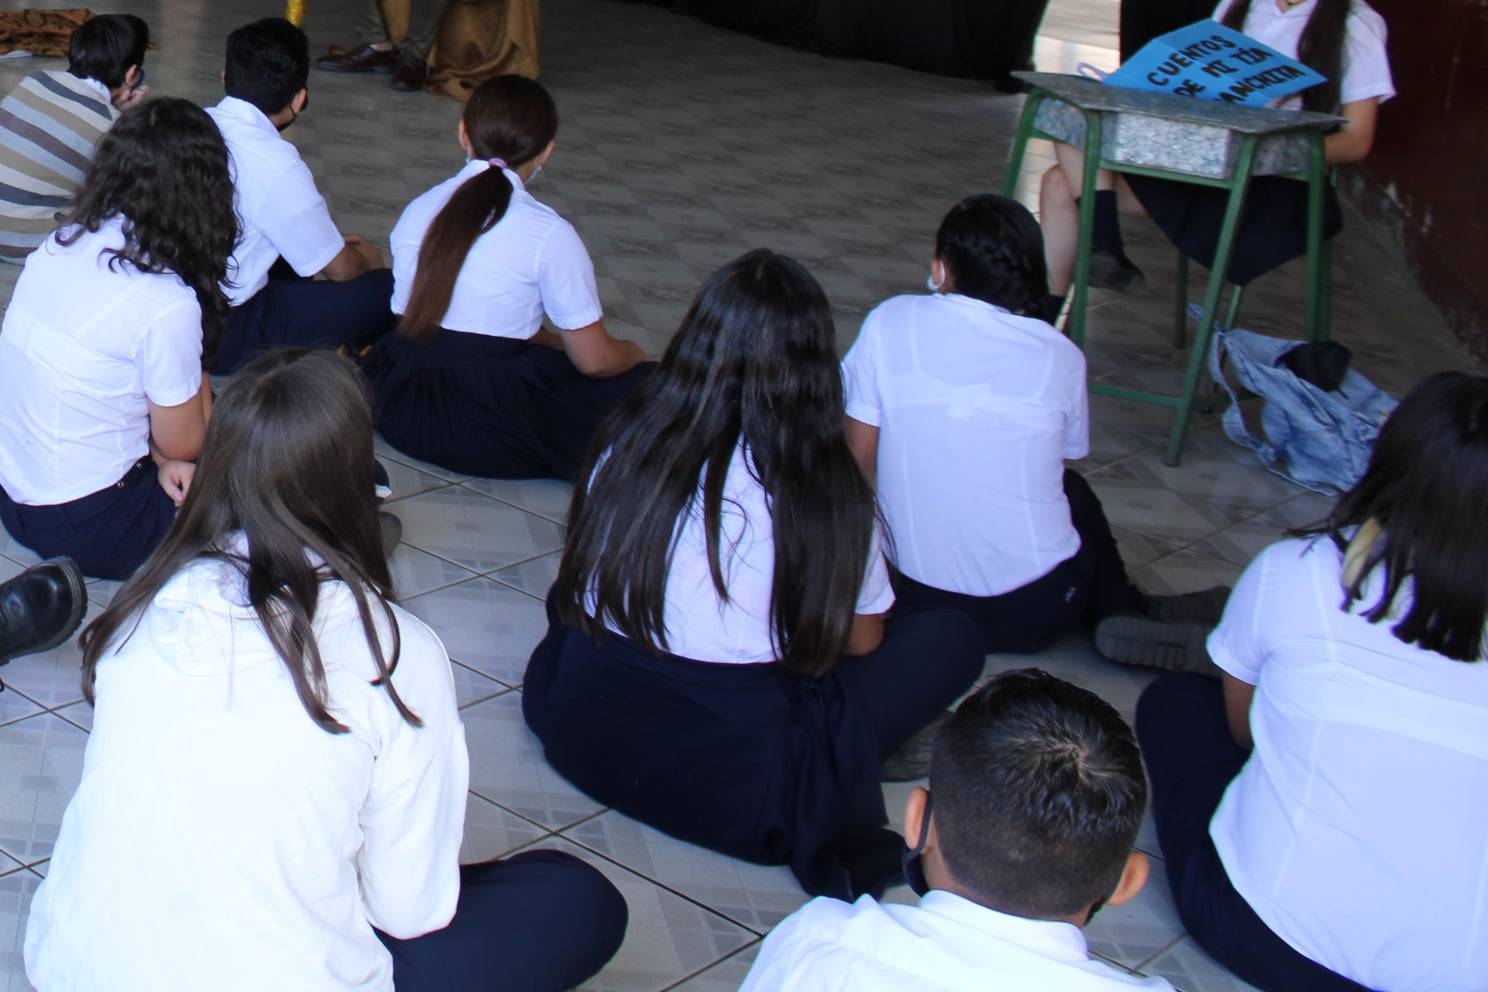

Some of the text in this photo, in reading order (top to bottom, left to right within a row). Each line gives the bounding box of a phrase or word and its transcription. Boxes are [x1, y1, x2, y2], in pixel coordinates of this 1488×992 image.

[1147, 35, 1236, 86] CUENTOS
[1174, 79, 1206, 96] DE
[1201, 60, 1238, 78] MI
[1214, 64, 1306, 104] ANCHITA
